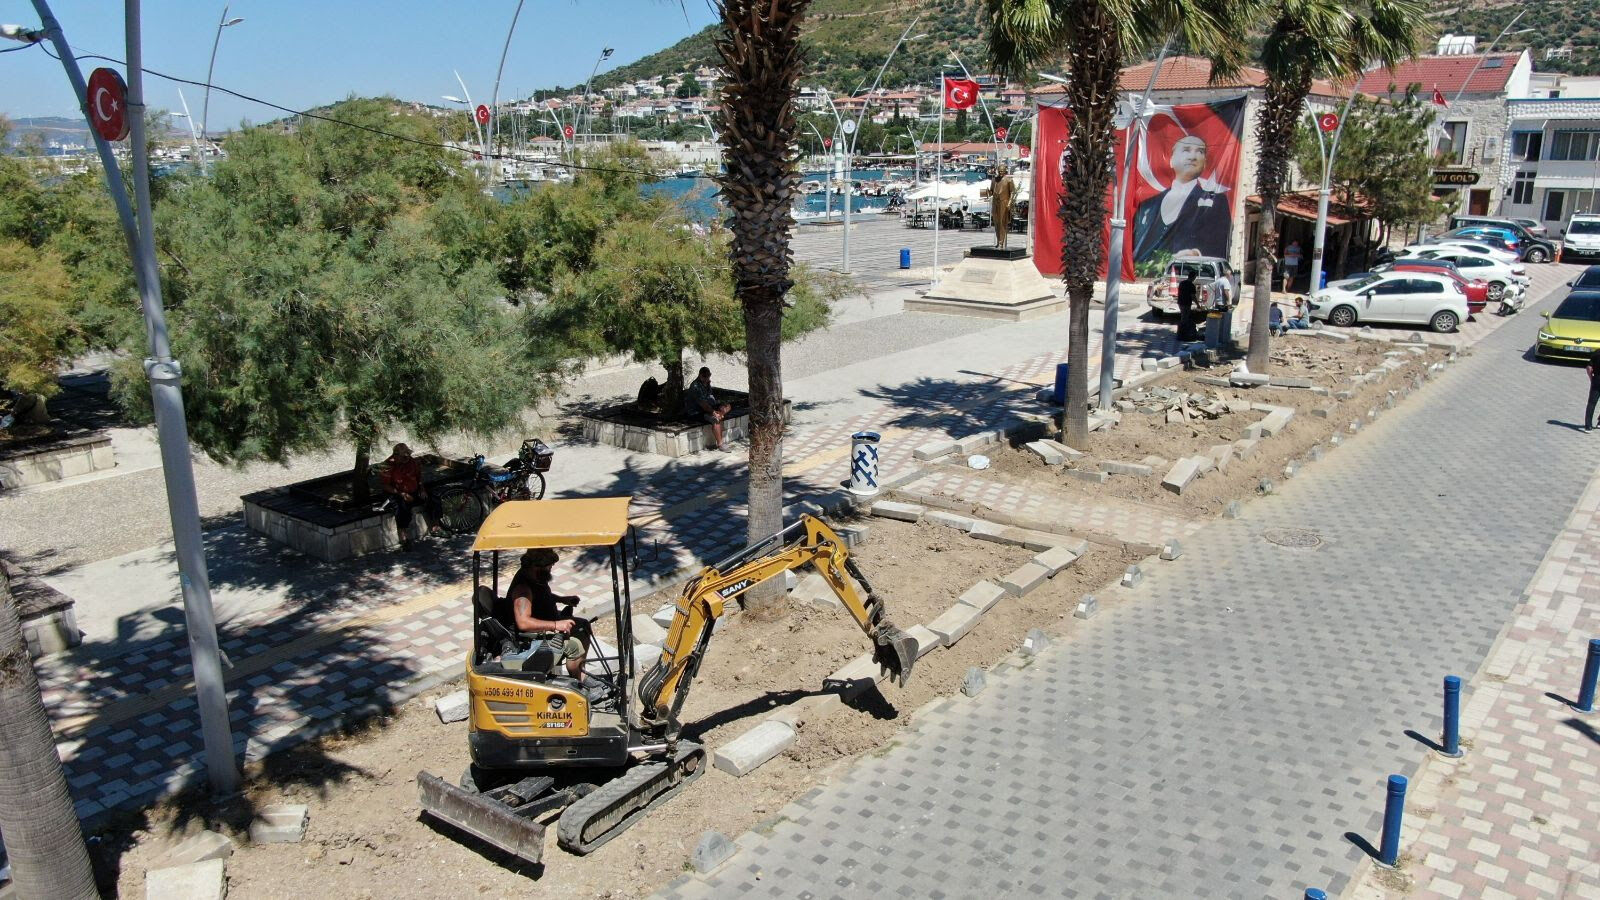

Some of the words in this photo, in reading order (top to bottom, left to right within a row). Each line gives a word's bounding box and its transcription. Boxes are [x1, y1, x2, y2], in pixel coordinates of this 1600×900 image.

[1449, 174, 1476, 182] GOLD
[721, 580, 748, 597] SANY
[484, 687, 501, 696] 0506
[501, 688, 515, 697] 499
[515, 688, 524, 698] 41
[525, 689, 534, 698] 68
